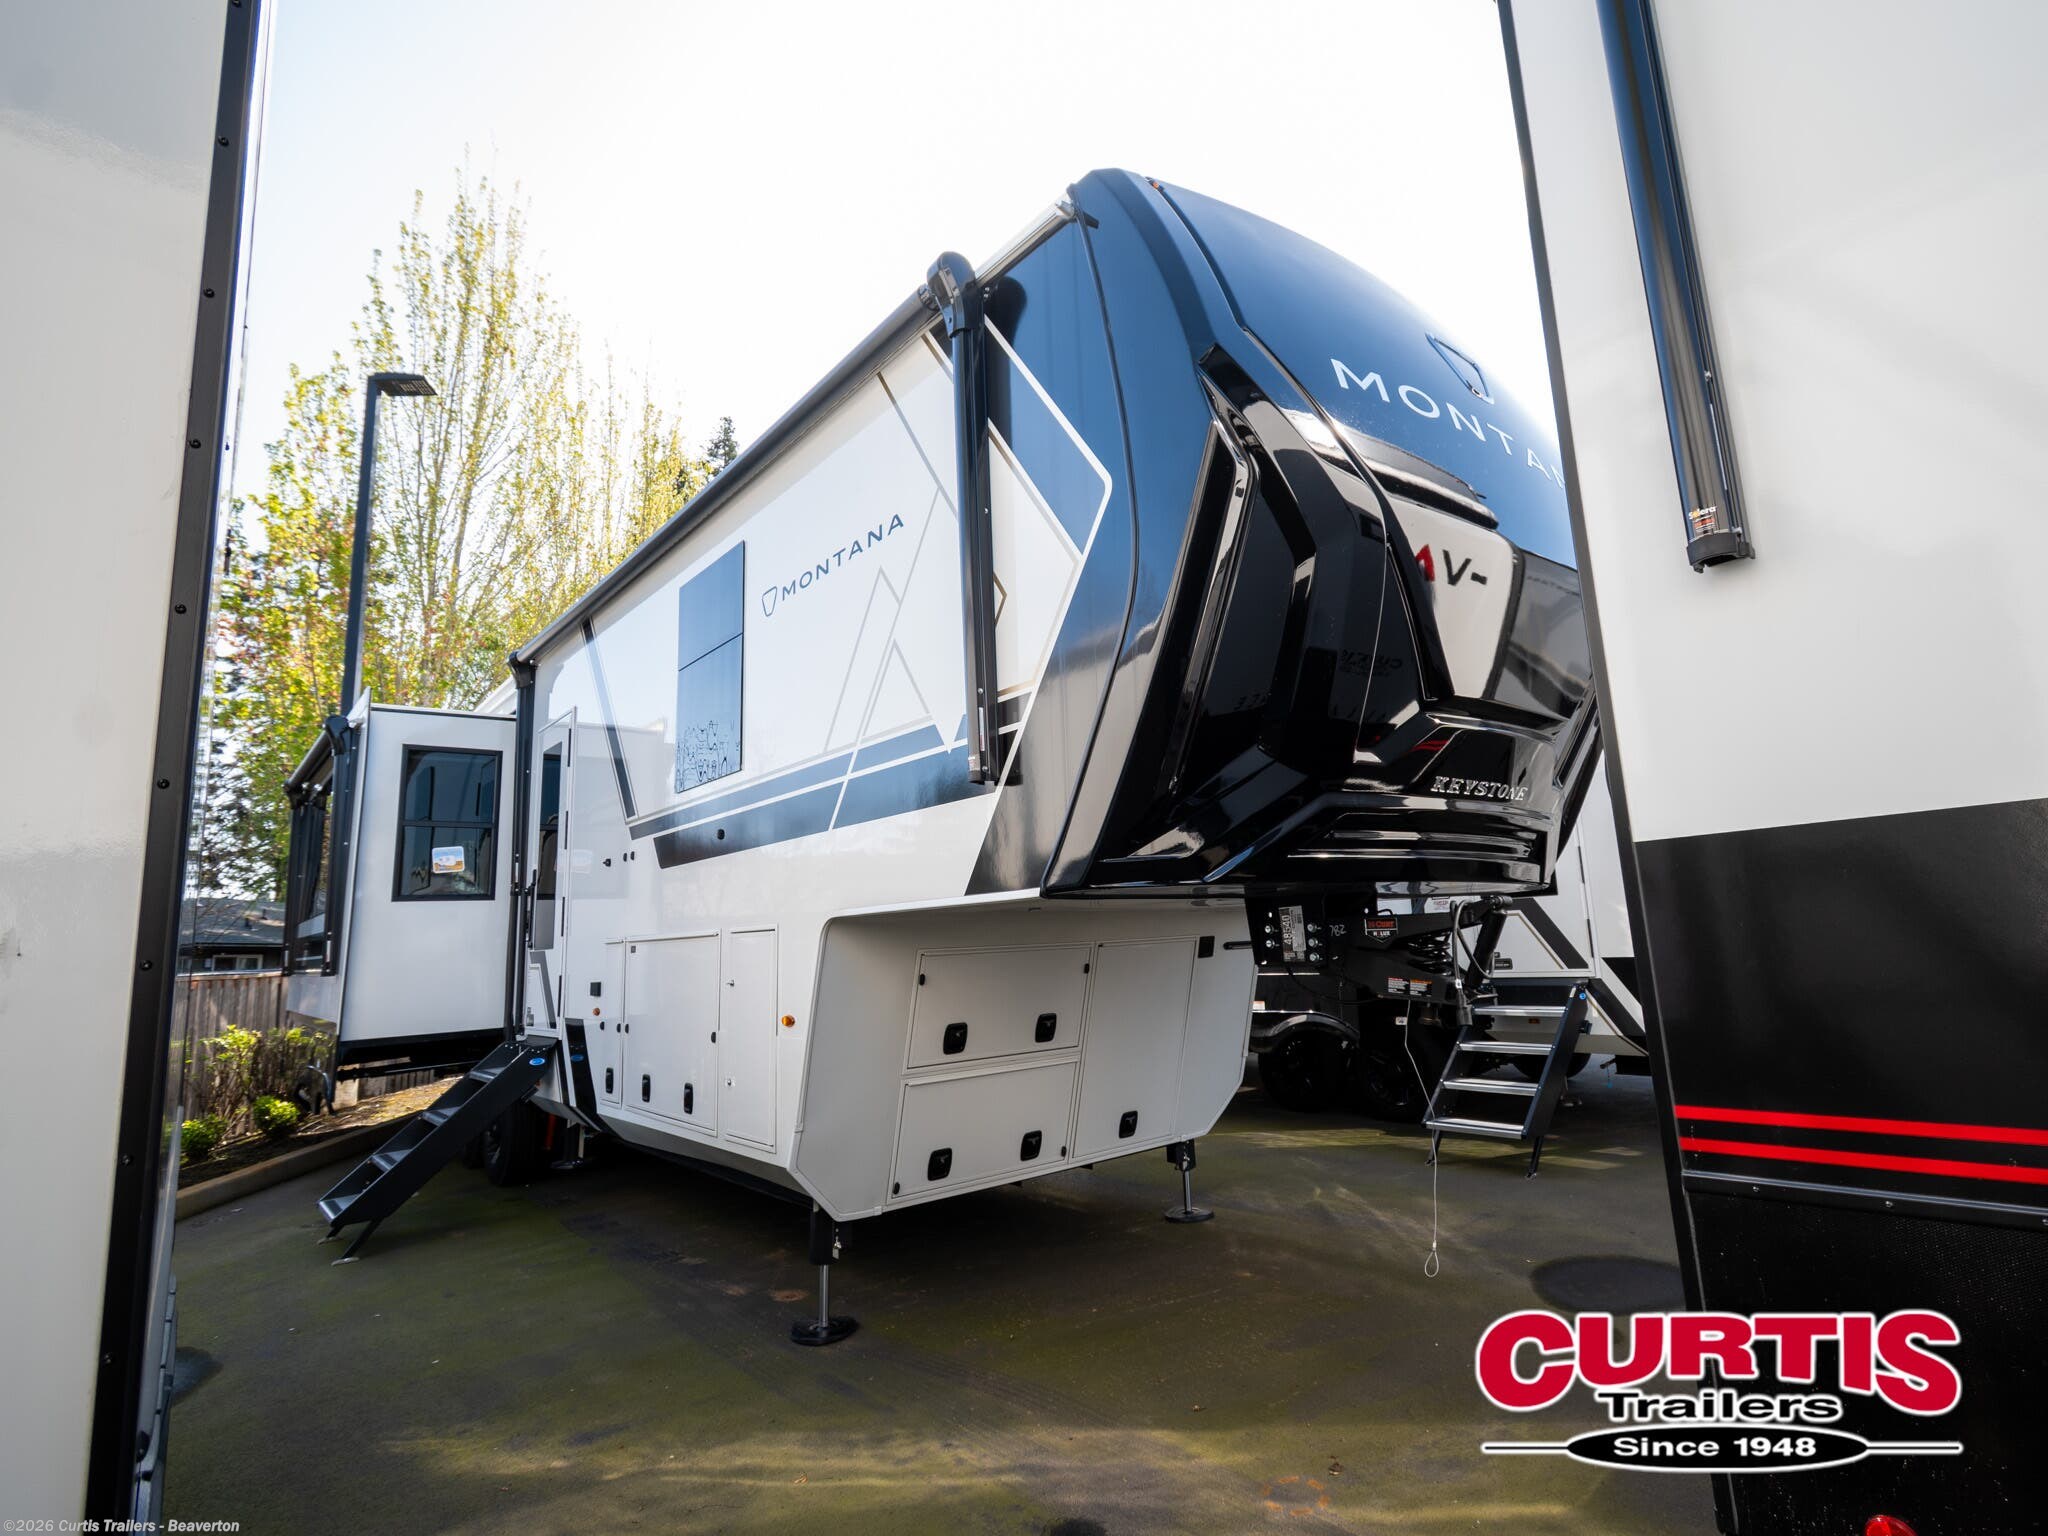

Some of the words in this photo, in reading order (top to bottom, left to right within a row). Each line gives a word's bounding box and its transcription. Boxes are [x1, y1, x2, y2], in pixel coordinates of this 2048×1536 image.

[1330, 358, 1565, 489] MONTAN
[782, 513, 904, 601] MONTANA
[1431, 775, 1528, 801] KEYSTONE
[1281, 914, 1292, 945] 48540
